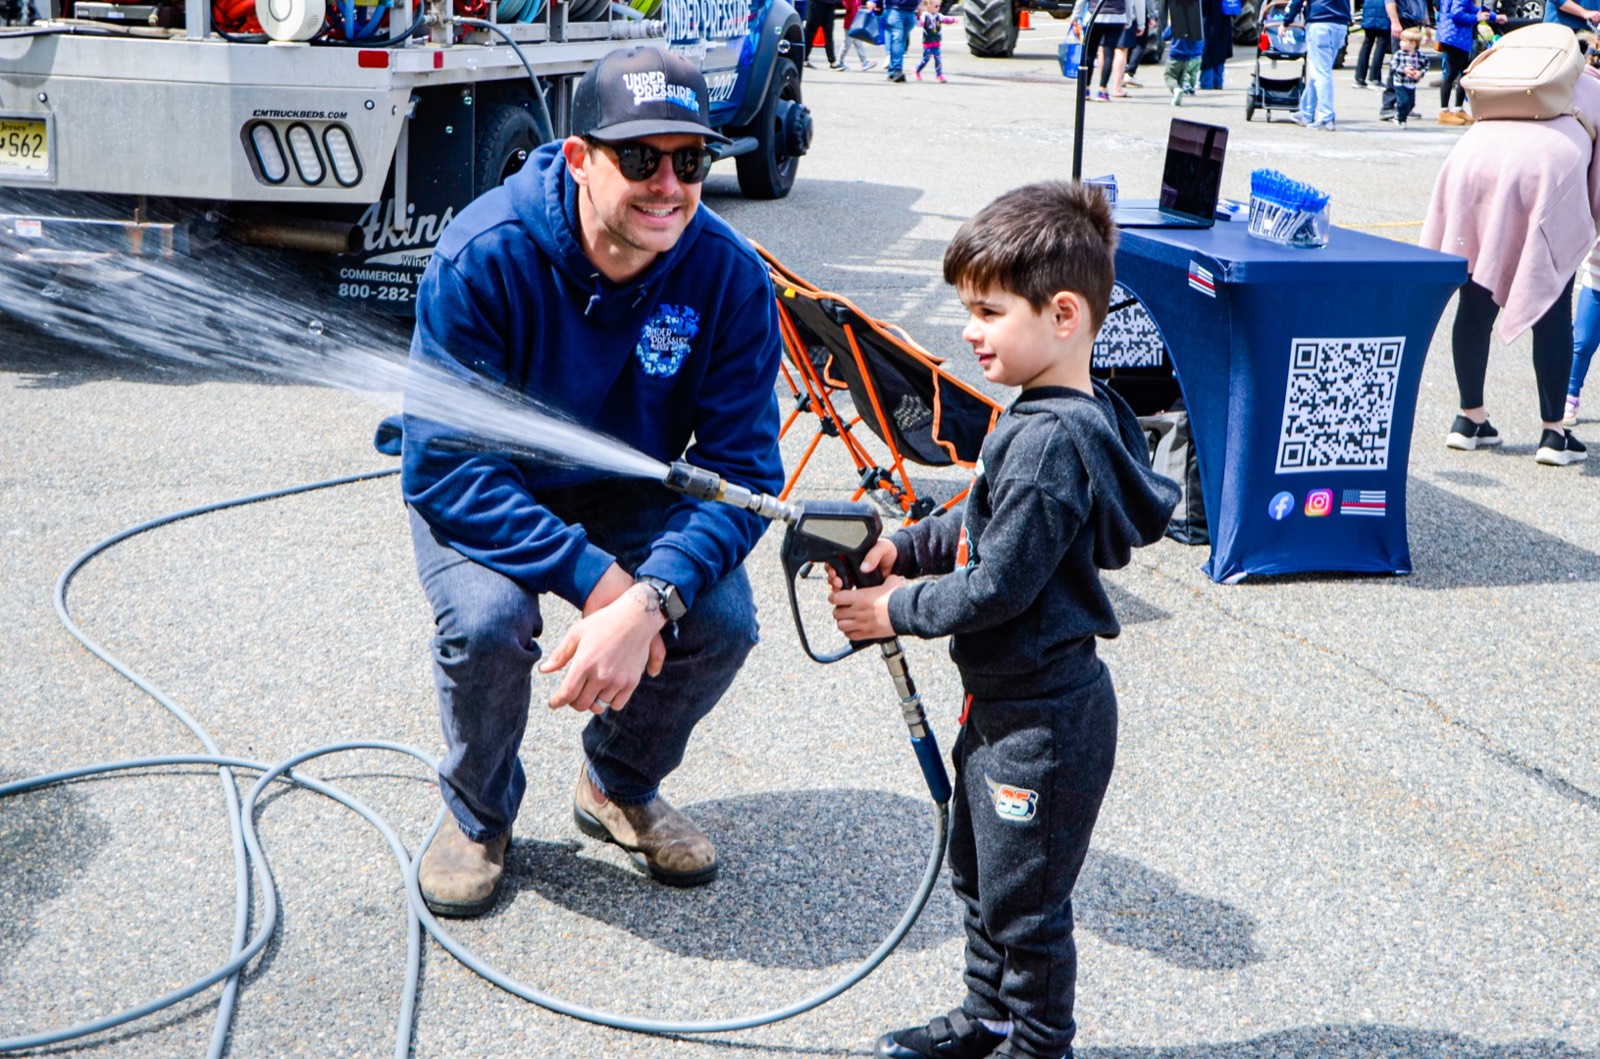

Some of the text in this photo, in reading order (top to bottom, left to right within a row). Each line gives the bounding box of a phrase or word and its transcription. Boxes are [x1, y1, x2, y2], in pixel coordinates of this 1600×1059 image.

[662, 0, 752, 49] UNDER PRESSURE
[622, 71, 666, 90] UNDER
[252, 109, 348, 119] CMTRUCKBEDS.COM
[340, 268, 413, 284] COMMERCIAL
[998, 788, 1031, 817] 95
